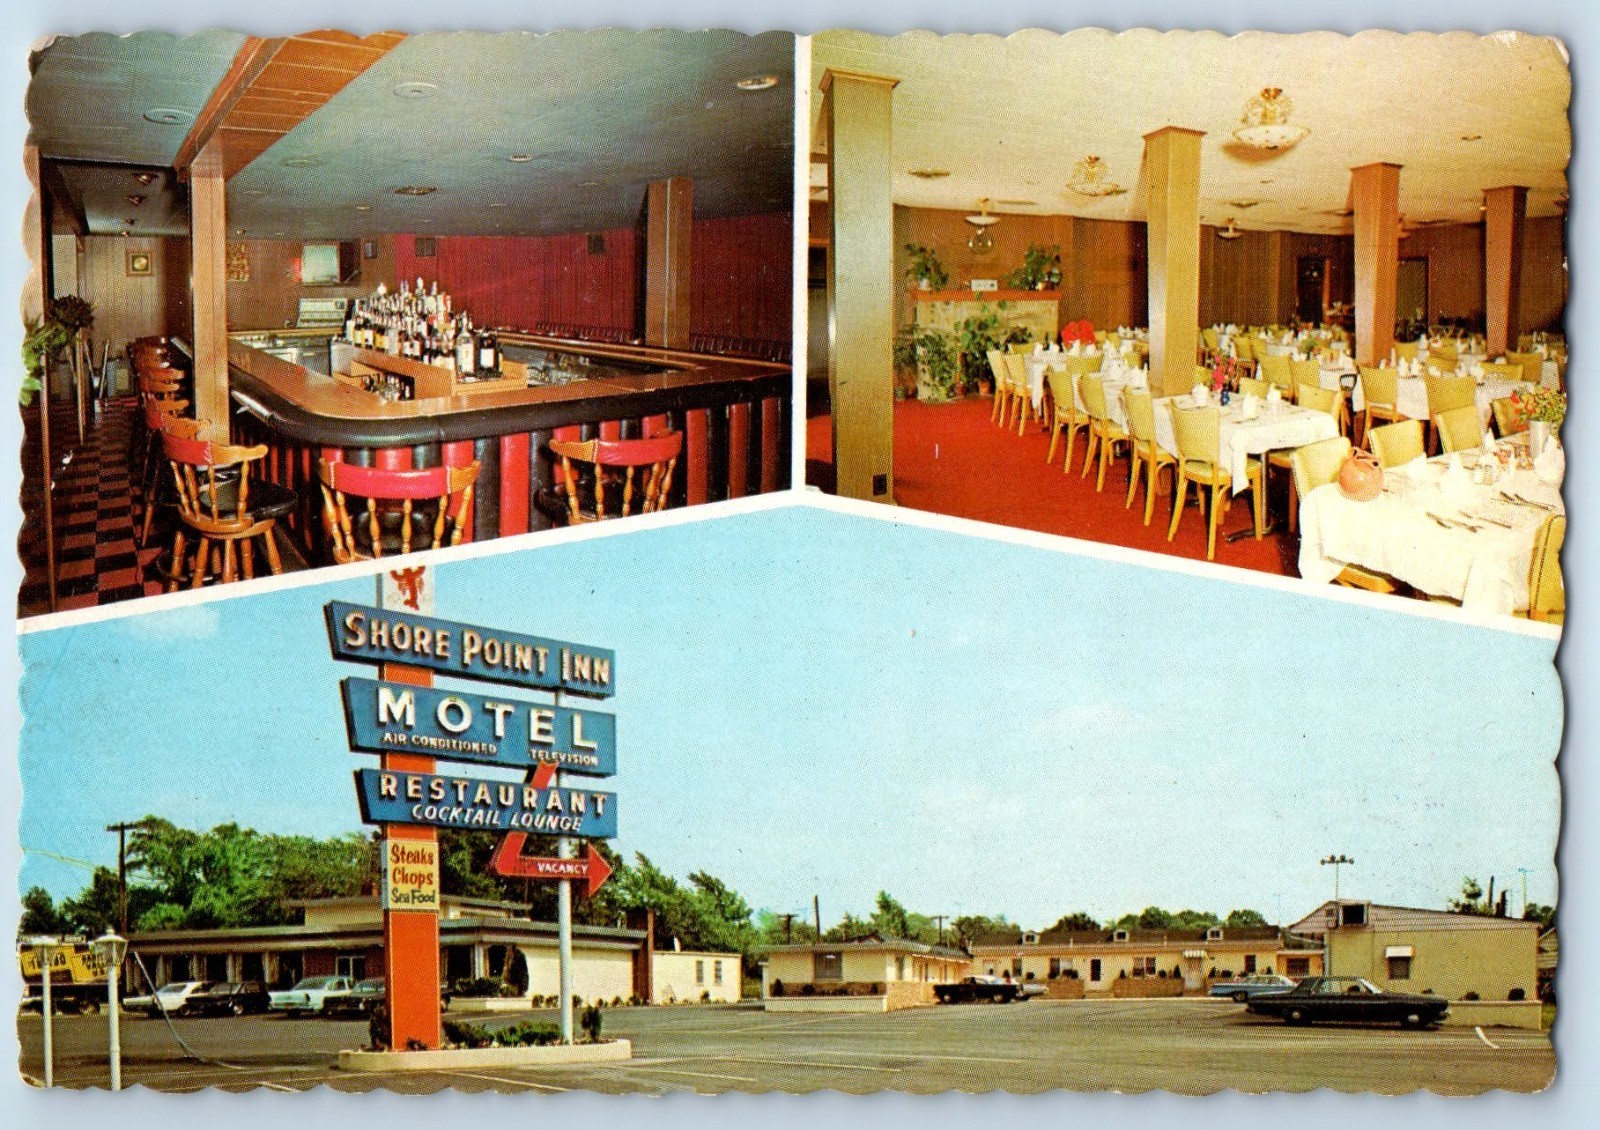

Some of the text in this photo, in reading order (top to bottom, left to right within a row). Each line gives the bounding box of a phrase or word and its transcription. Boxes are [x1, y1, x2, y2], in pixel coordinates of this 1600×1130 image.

[345, 610, 611, 685] SHORE POINT INN
[377, 687, 598, 749] MOTEL
[383, 732, 599, 767] AIR CONDITIONED TELEVISION
[379, 773, 608, 816] RESTAURANT
[411, 803, 583, 832] COCKTAIL LOUNGE
[390, 843, 434, 866] Steaks
[537, 862, 589, 875] VACANCY
[392, 867, 434, 889] Chops
